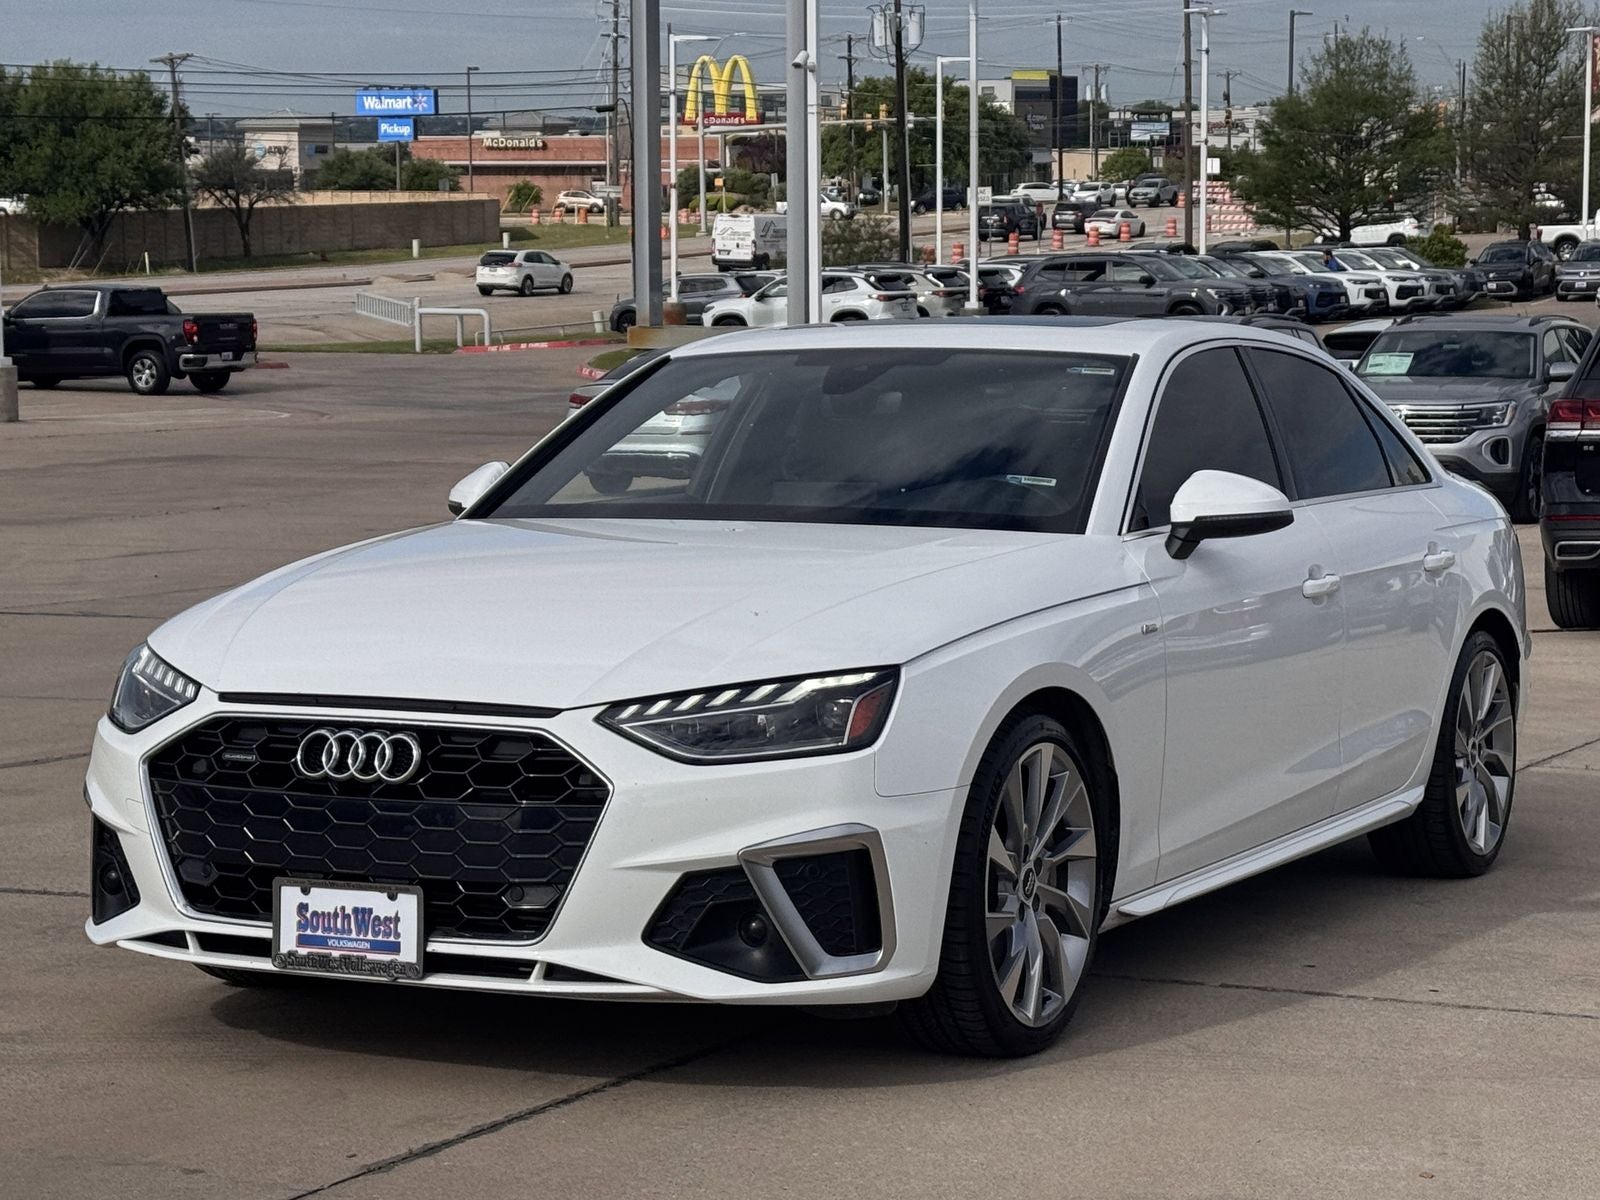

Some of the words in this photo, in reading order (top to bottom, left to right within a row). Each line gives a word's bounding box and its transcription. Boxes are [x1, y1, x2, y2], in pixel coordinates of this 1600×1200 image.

[363, 96, 413, 110] Walmart
[381, 123, 410, 136] Pickup
[482, 138, 543, 147] McDonald's
[297, 902, 401, 939] SouthWest
[327, 938, 371, 950] VOLKSWAGEN
